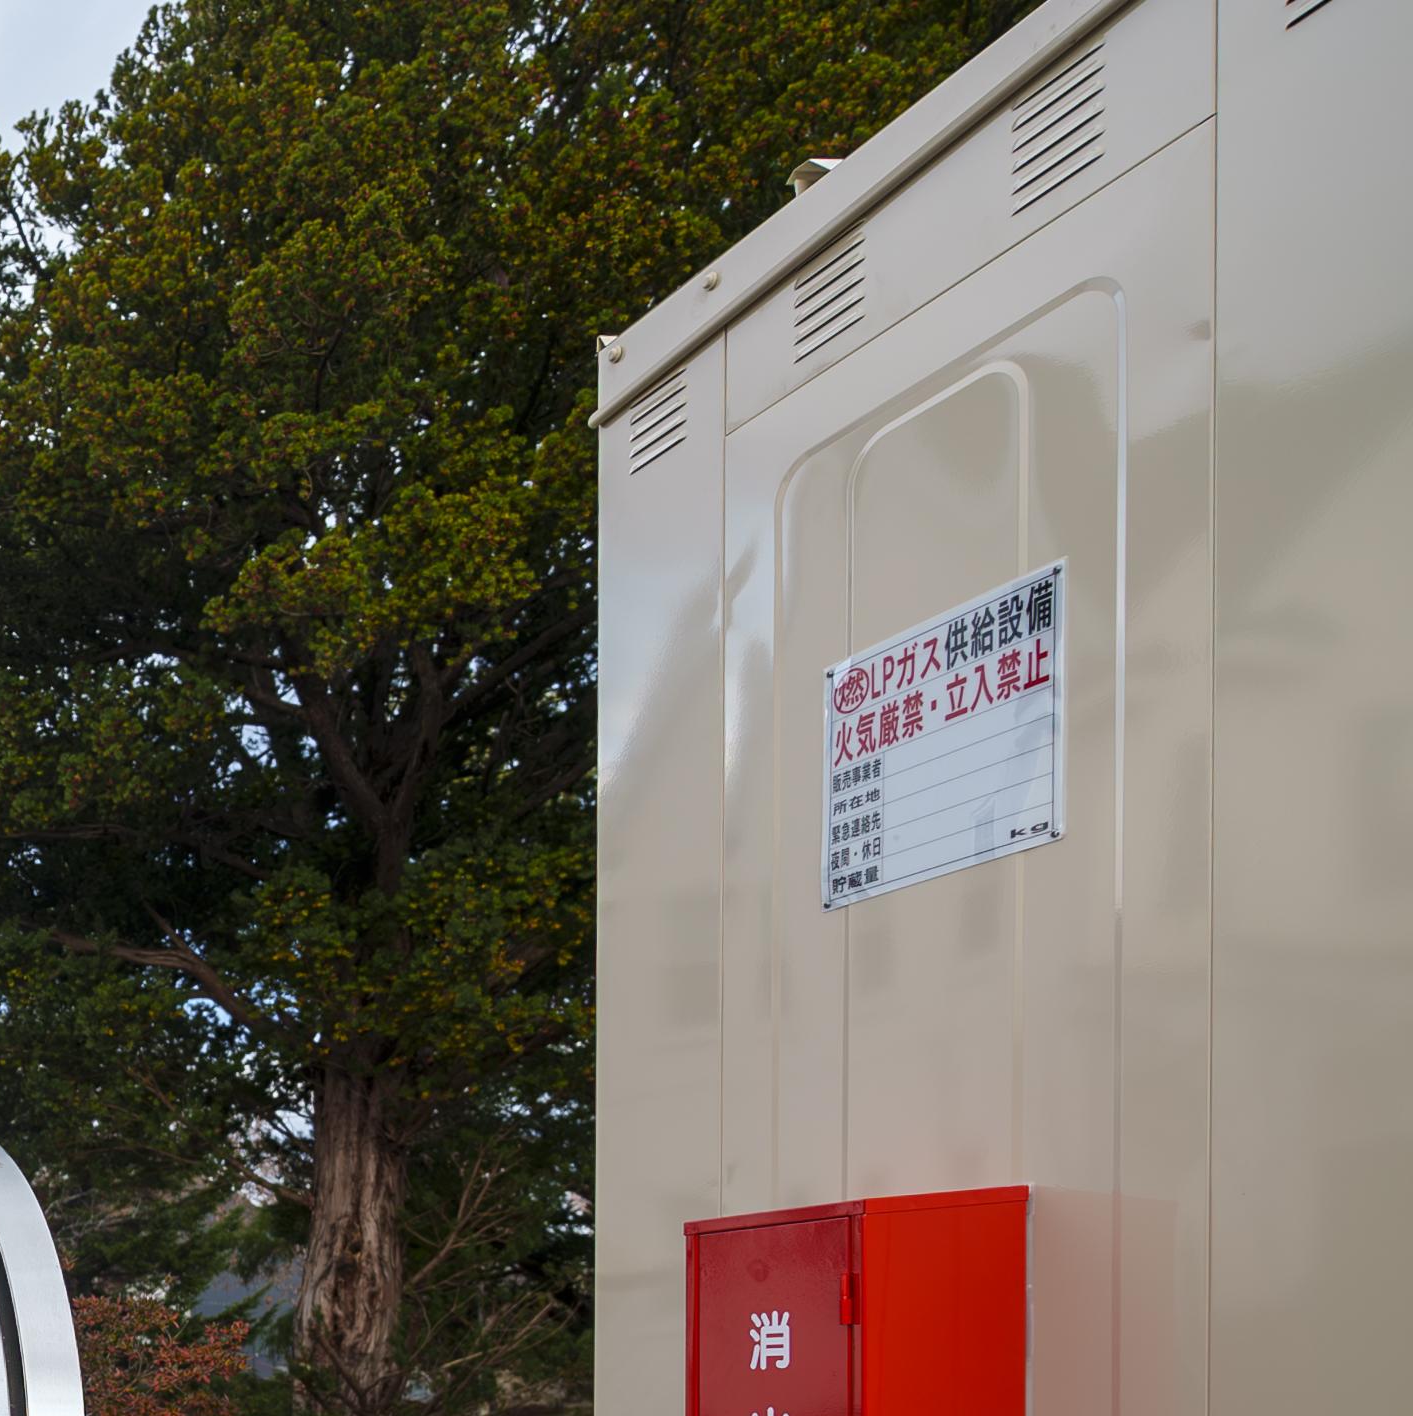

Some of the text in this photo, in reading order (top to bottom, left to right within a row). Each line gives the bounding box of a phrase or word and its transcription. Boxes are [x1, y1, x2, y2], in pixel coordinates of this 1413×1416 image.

[834, 638, 1051, 767] 火気厳禁・立入禁止
[832, 758, 882, 794] 販売事業者
[833, 787, 881, 817] 所在地
[831, 811, 881, 845] 緊急連絡先
[832, 865, 880, 895] 貯蔵量
